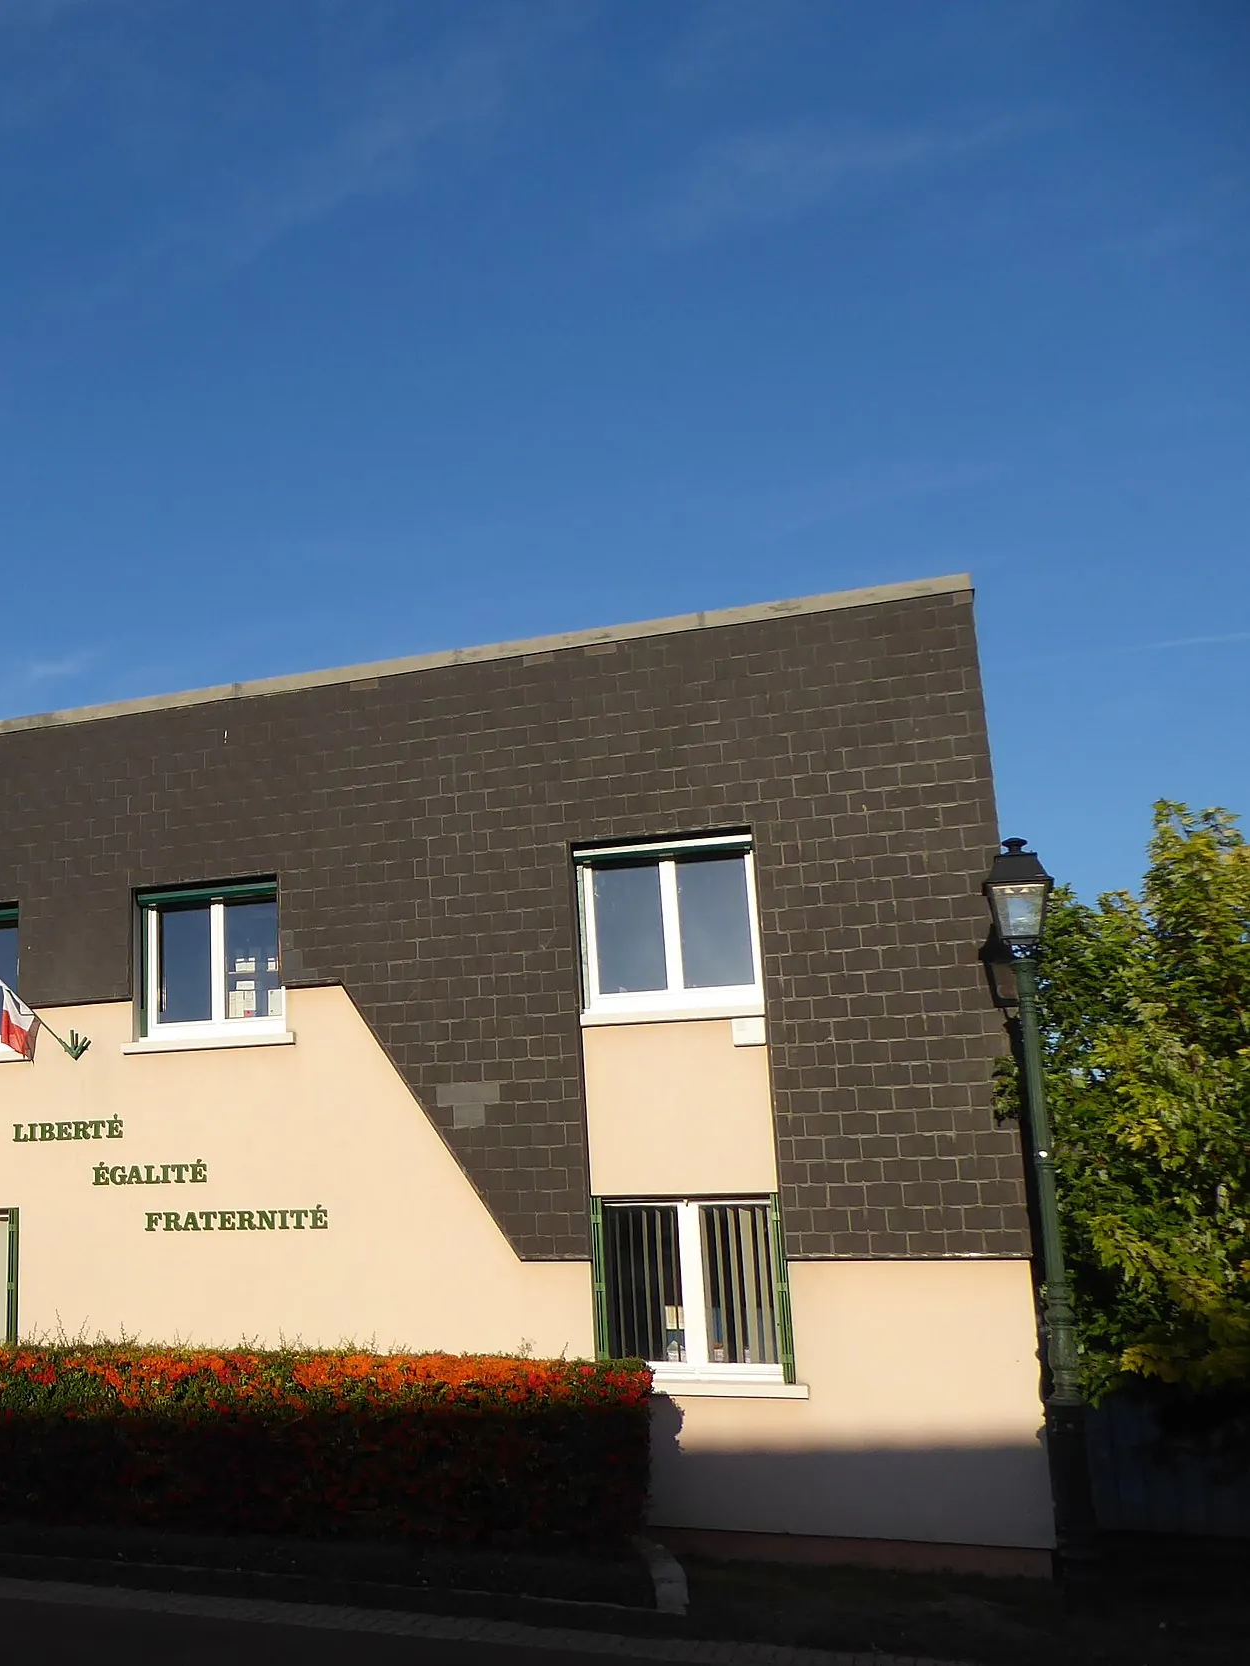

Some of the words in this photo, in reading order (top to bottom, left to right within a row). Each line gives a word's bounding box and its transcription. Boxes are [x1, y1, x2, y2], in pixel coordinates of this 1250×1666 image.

[12, 1114, 124, 1142] LIBERTÉ
[92, 1159, 207, 1186] ÉGALITÉ
[144, 1204, 328, 1231] FRATERNITÉ
